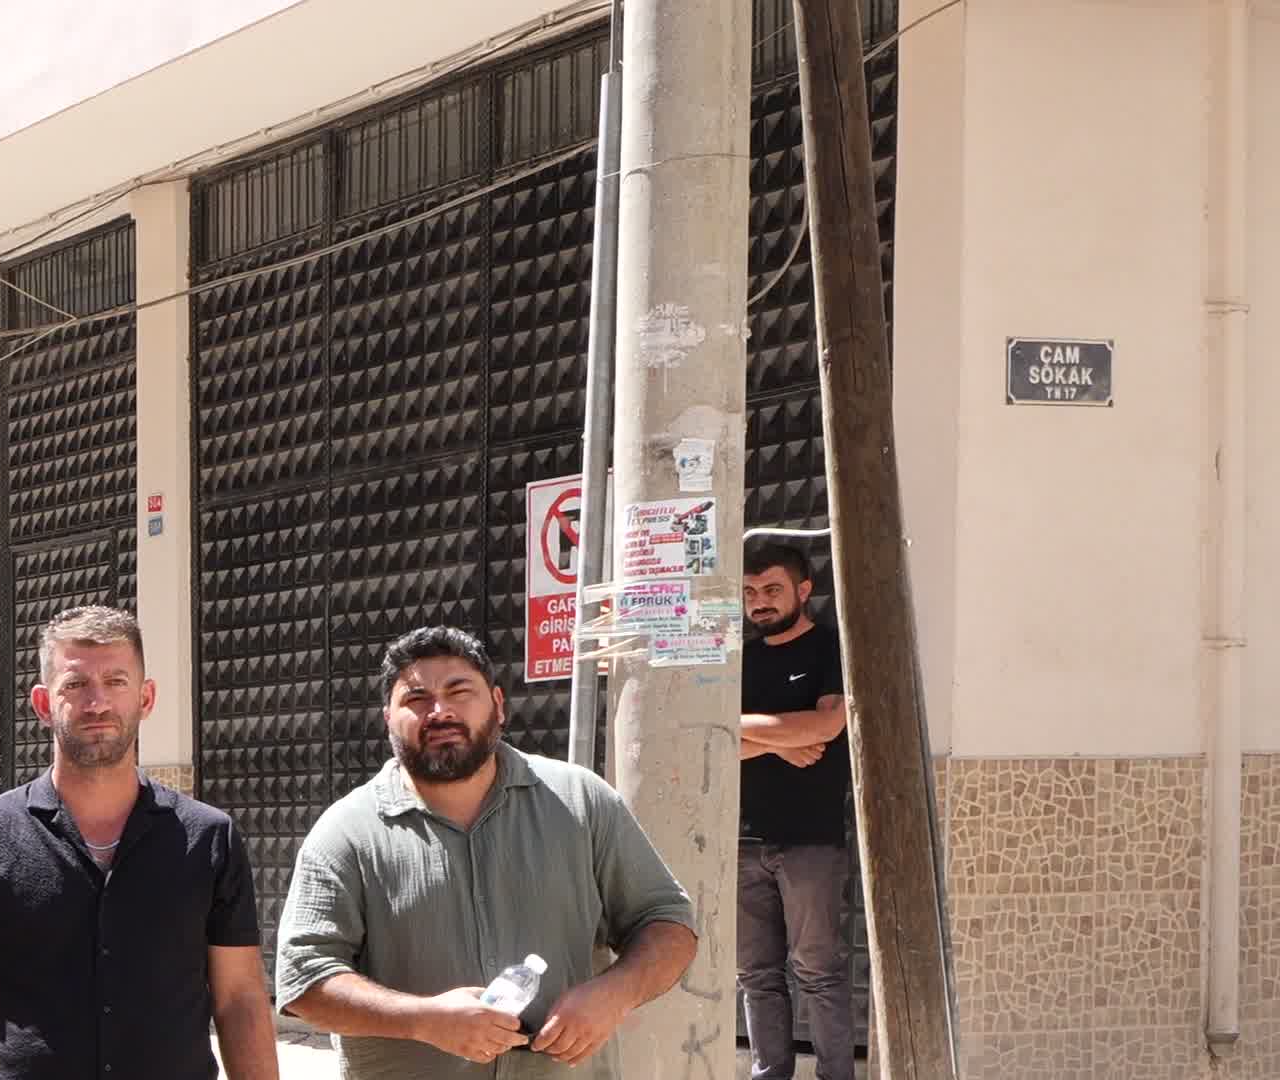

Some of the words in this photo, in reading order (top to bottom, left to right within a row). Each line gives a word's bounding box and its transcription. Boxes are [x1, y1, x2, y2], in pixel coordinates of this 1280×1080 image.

[1040, 345, 1080, 367] ÇAM
[1028, 366, 1094, 385] SOKAK
[547, 597, 576, 614] GAR
[552, 638, 574, 653] PA
